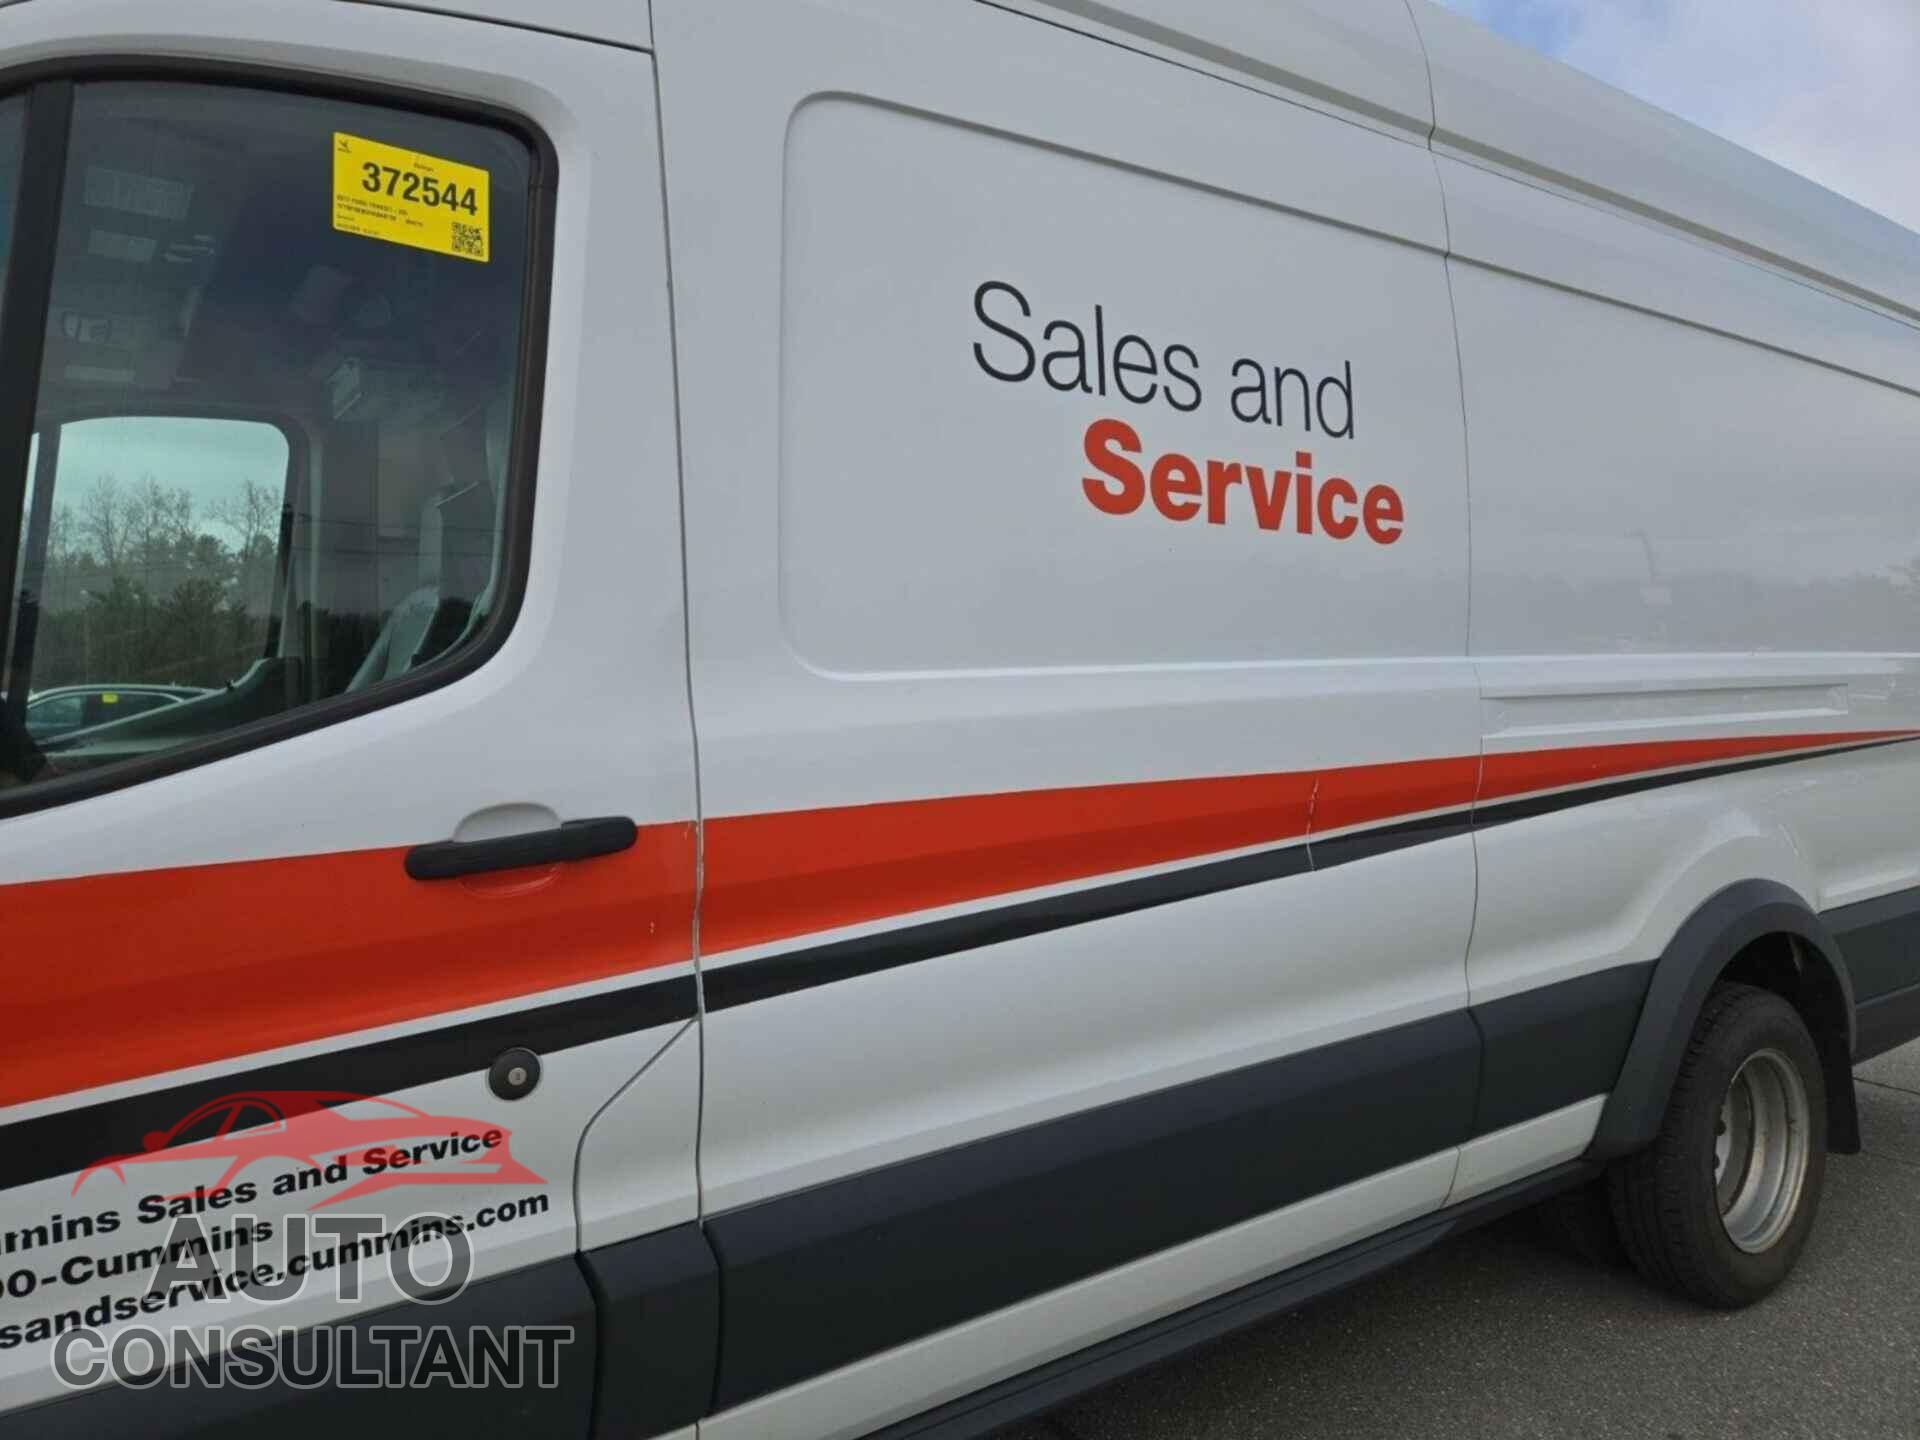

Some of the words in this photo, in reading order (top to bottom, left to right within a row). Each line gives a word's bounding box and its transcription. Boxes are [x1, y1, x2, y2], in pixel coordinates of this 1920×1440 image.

[362, 162, 477, 216] 372544
[973, 280, 1202, 412] Sales
[1231, 358, 1354, 440] and
[1082, 418, 1404, 545] Service
[0, 1210, 121, 1255] mins
[137, 1180, 258, 1224] Sales
[272, 1156, 348, 1196] and
[362, 1128, 503, 1175] Service
[0, 1220, 274, 1299] 0-Cummins
